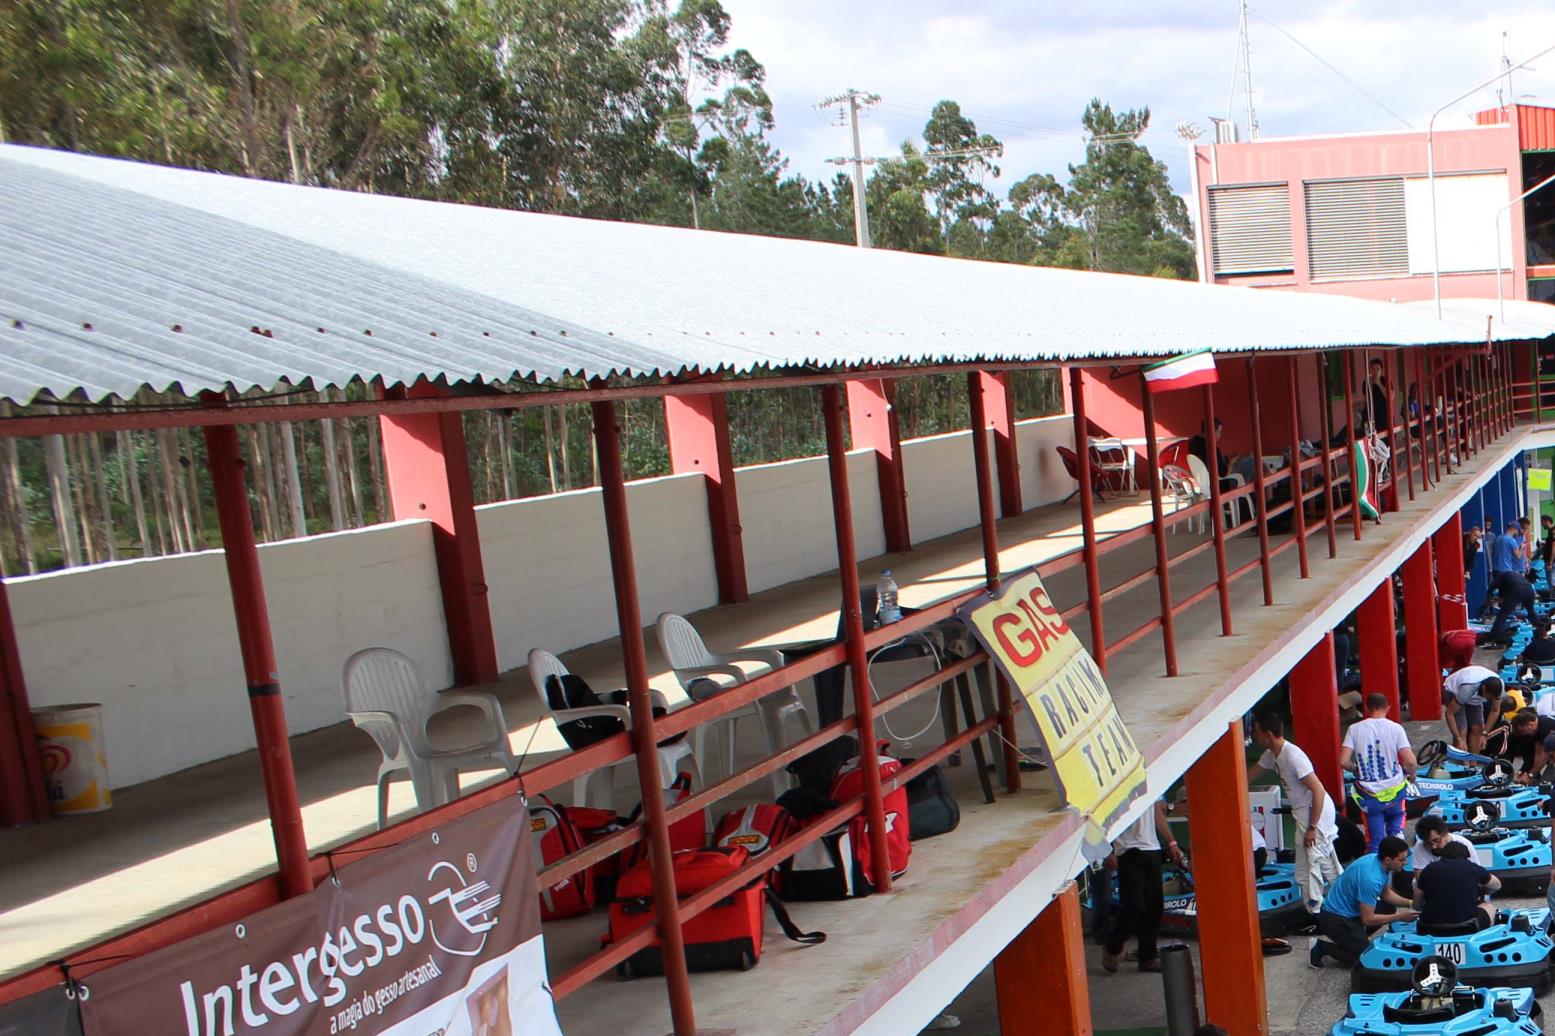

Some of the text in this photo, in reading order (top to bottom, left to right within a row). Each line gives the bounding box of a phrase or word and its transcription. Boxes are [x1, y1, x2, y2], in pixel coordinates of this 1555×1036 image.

[993, 587, 1070, 667] GAS
[1438, 942, 1462, 965] 140
[330, 955, 442, 1035] a magia do gesso artesanal
